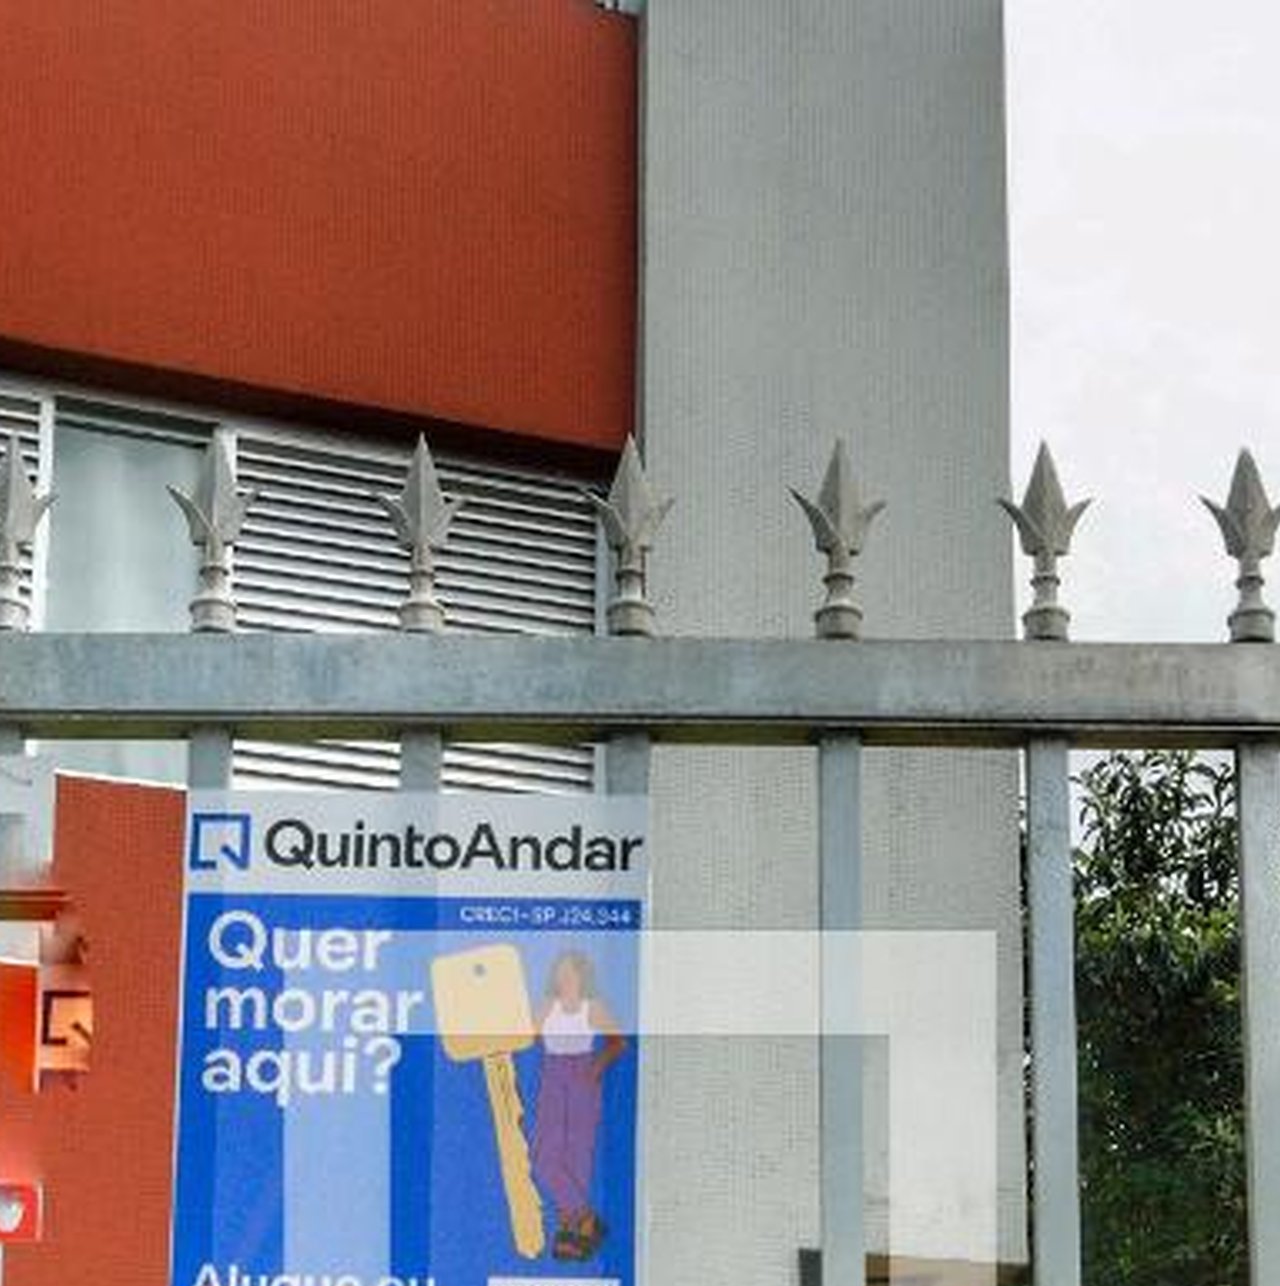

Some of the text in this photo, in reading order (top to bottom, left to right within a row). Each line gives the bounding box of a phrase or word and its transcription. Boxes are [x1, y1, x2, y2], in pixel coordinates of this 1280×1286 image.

[264, 818, 644, 871] QuintoAndar
[208, 909, 392, 972] Quer
[204, 986, 425, 1033] morar
[201, 1034, 403, 1108] aqui?
